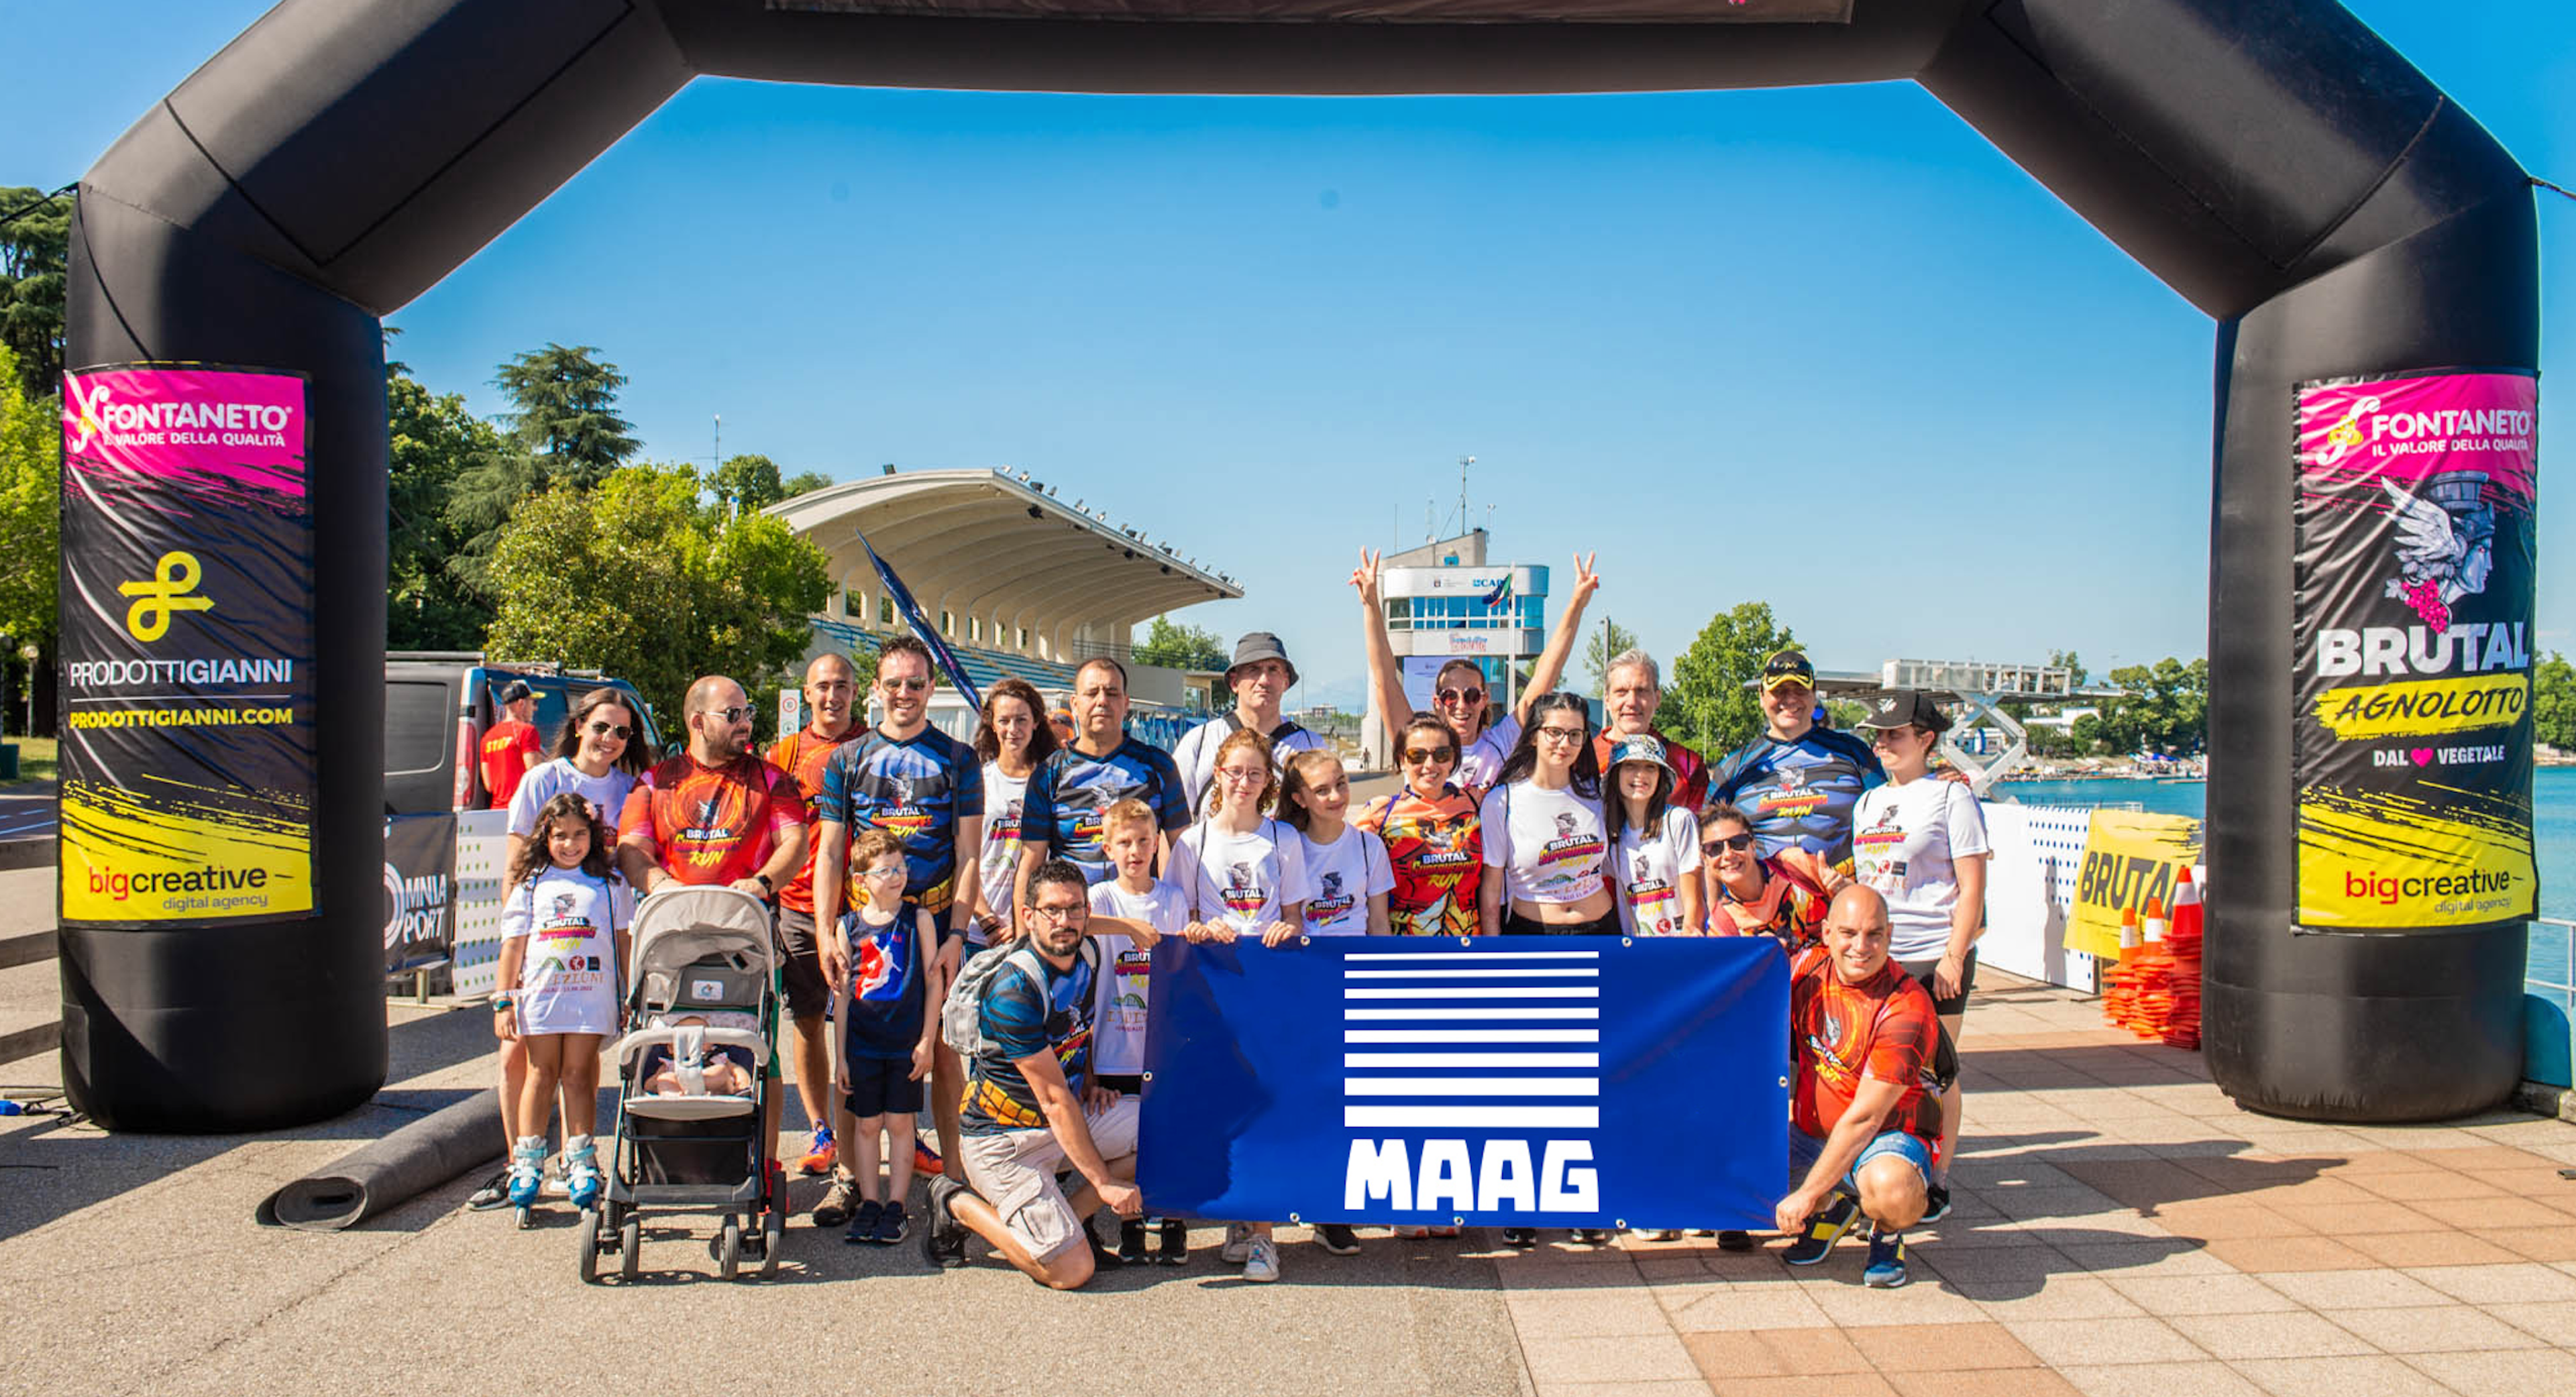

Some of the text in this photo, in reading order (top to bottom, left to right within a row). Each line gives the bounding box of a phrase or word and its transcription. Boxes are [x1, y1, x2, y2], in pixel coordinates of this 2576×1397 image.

[104, 402, 288, 431] FONTANETO
[2371, 409, 2530, 441] FONTANETO
[115, 433, 165, 445] VALORE
[170, 432, 218, 445] DELLA
[222, 431, 286, 448] QUALITÀ
[2372, 444, 2387, 457] IL
[2389, 439, 2447, 455] VALORE
[2451, 439, 2490, 452] DELLA
[2316, 621, 2531, 677] BRUTAL
[70, 659, 292, 687] PRODOTTIGIANNI
[2335, 686, 2524, 722] AGNOLOTTO
[69, 708, 293, 730] PRODOTTIGIANNI.COM
[2373, 744, 2506, 767] DAL VEGETALE
[1770, 788, 1814, 799] BRUTAL
[881, 806, 920, 817] BRUTAL
[1776, 803, 1813, 820] RUN
[998, 819, 1022, 829] BRUT
[686, 828, 729, 840] BRUTAL
[1549, 834, 1595, 851] BRUTAL
[688, 849, 726, 867] RUN
[1423, 851, 1467, 864] BRUTAL
[88, 866, 268, 901] bigcreative
[1428, 872, 1464, 890] RUN
[2345, 868, 2510, 905] bigcreative
[162, 895, 268, 912] digital agency
[2434, 896, 2512, 915] digital agency
[1124, 952, 1150, 962] BRUT
[1344, 1138, 1599, 1213] MAAG
